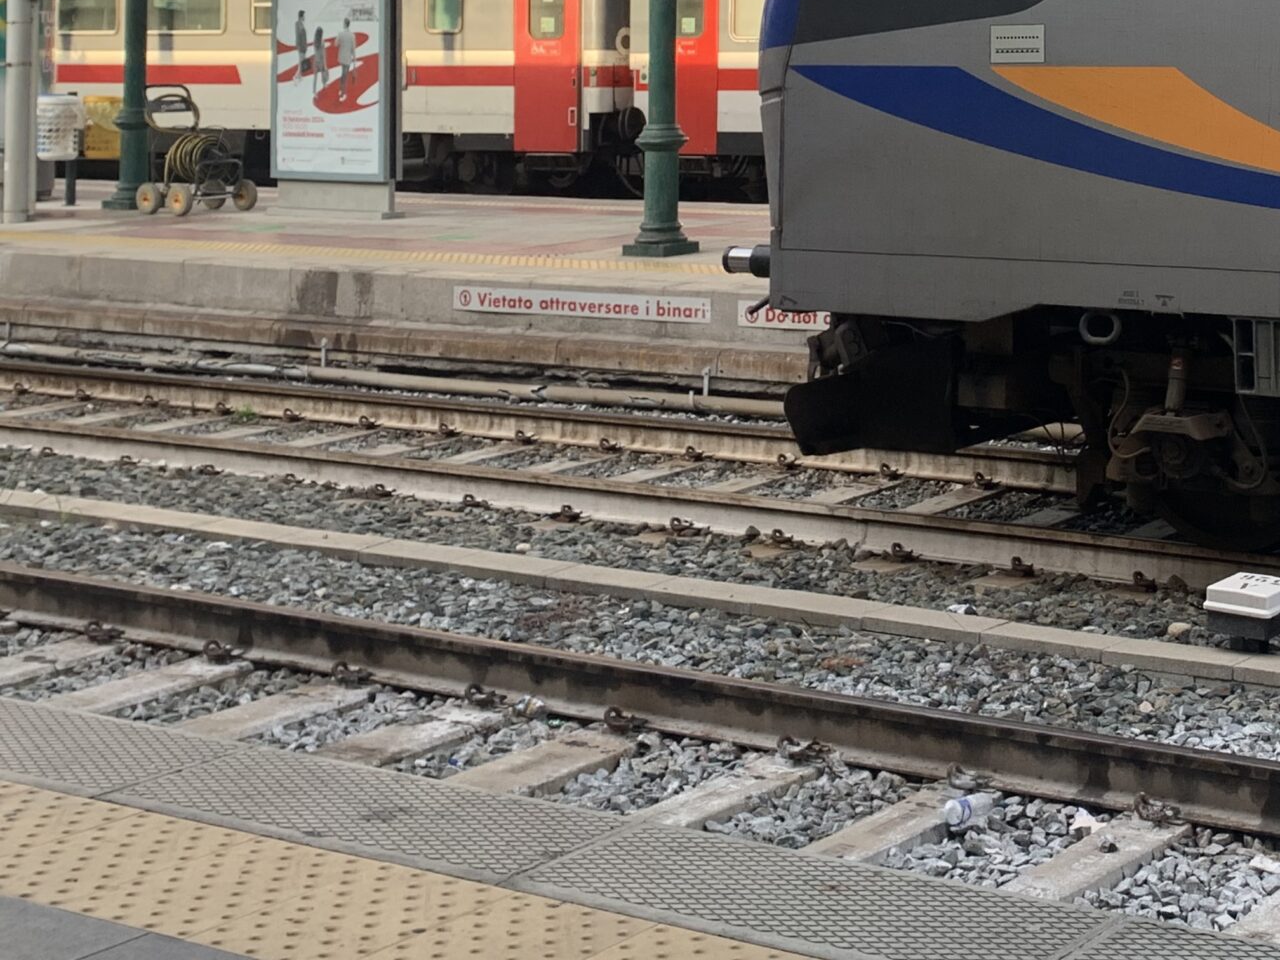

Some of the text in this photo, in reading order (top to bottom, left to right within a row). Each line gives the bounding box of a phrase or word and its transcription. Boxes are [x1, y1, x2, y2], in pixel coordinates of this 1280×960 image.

[477, 292, 707, 320] Vietato attraversare i binari
[765, 307, 786, 323] Do
